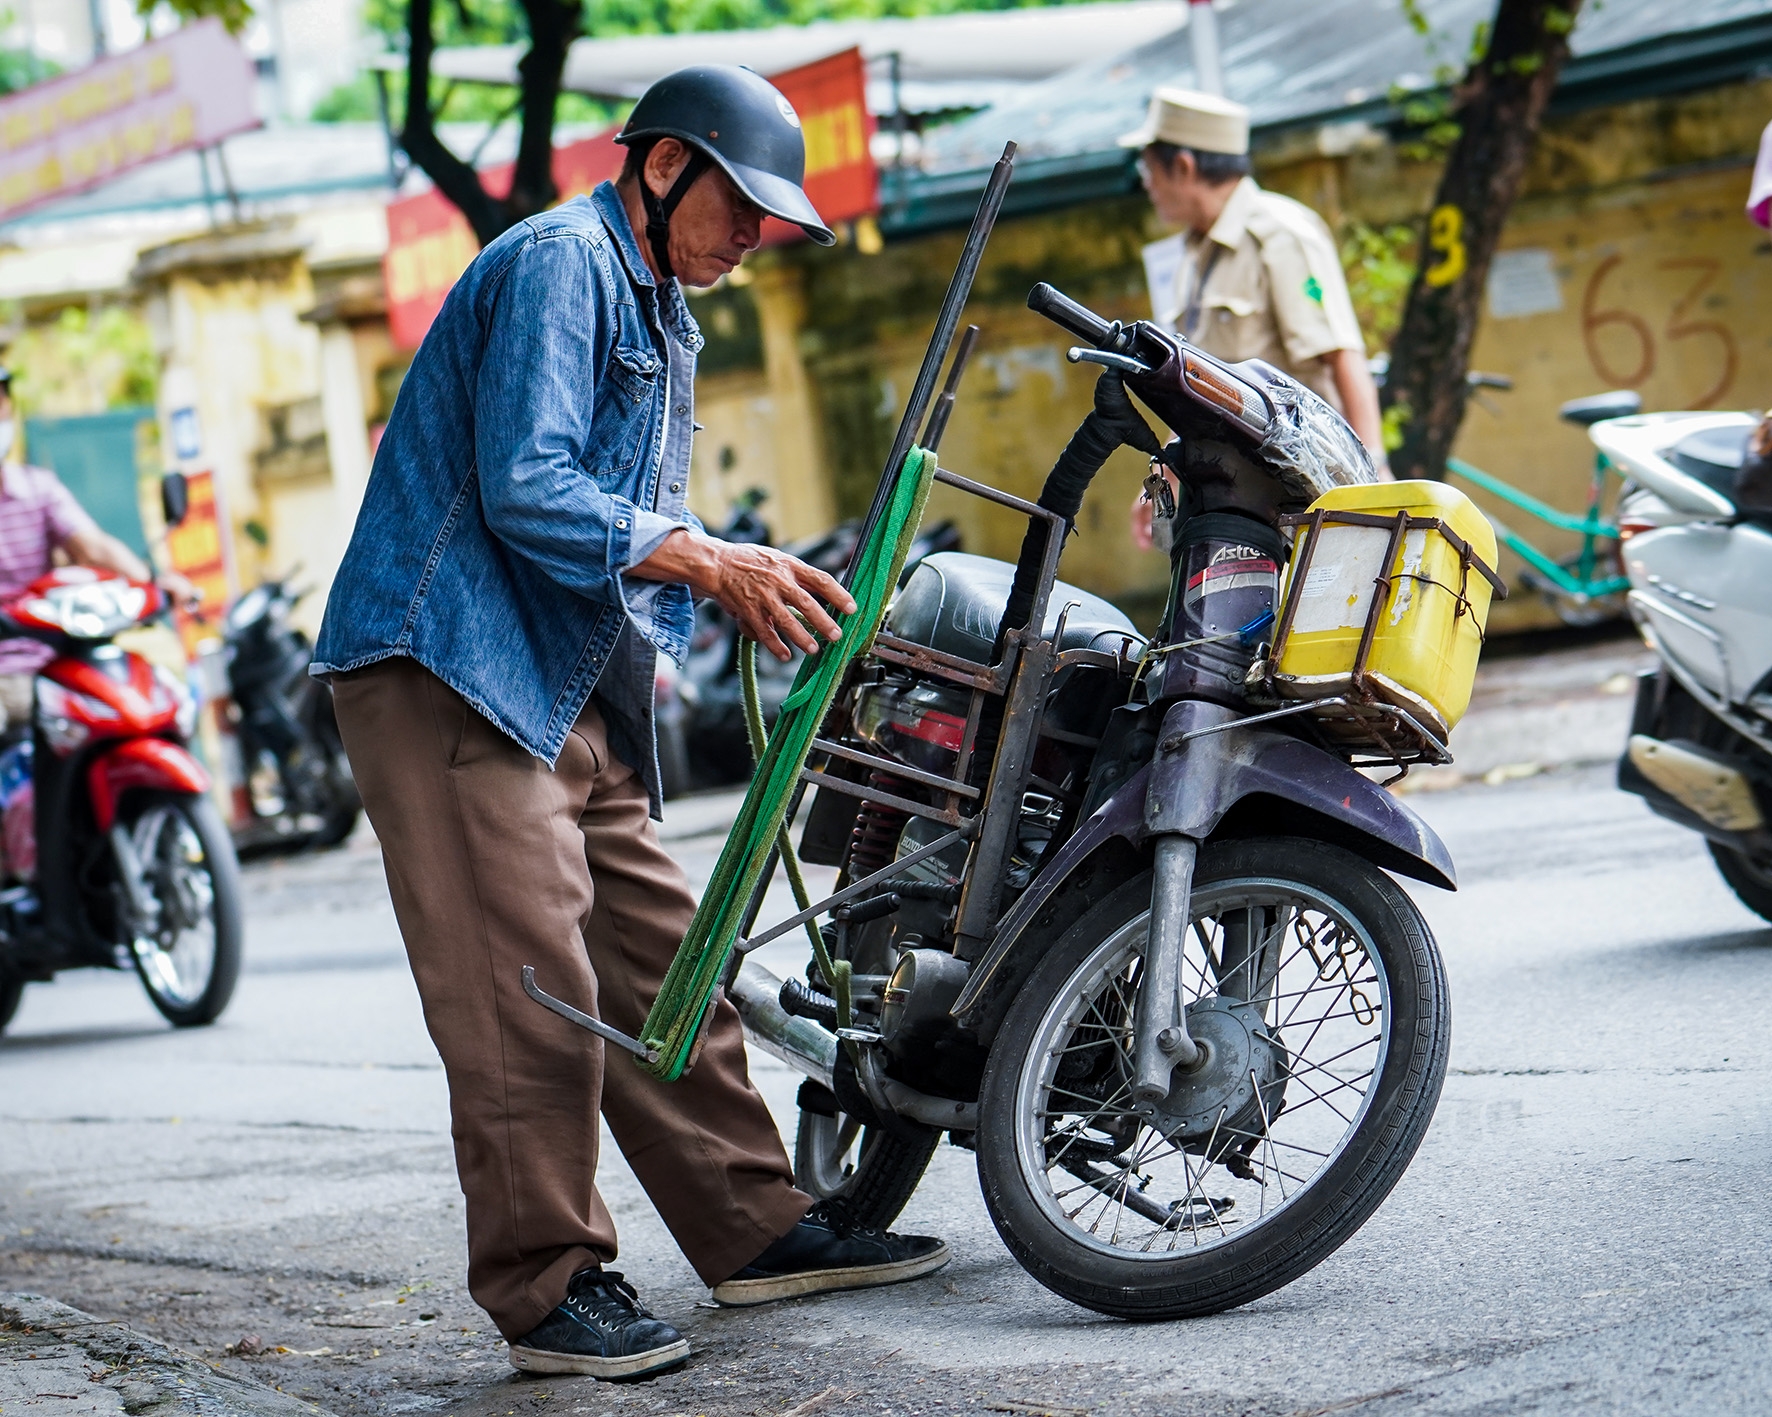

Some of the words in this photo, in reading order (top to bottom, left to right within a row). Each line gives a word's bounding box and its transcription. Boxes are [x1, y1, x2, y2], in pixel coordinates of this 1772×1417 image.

[1425, 203, 1467, 288] 3
[1580, 253, 1739, 412] 63
[1209, 545, 1267, 567] Astre
[901, 835, 925, 852] HOND
